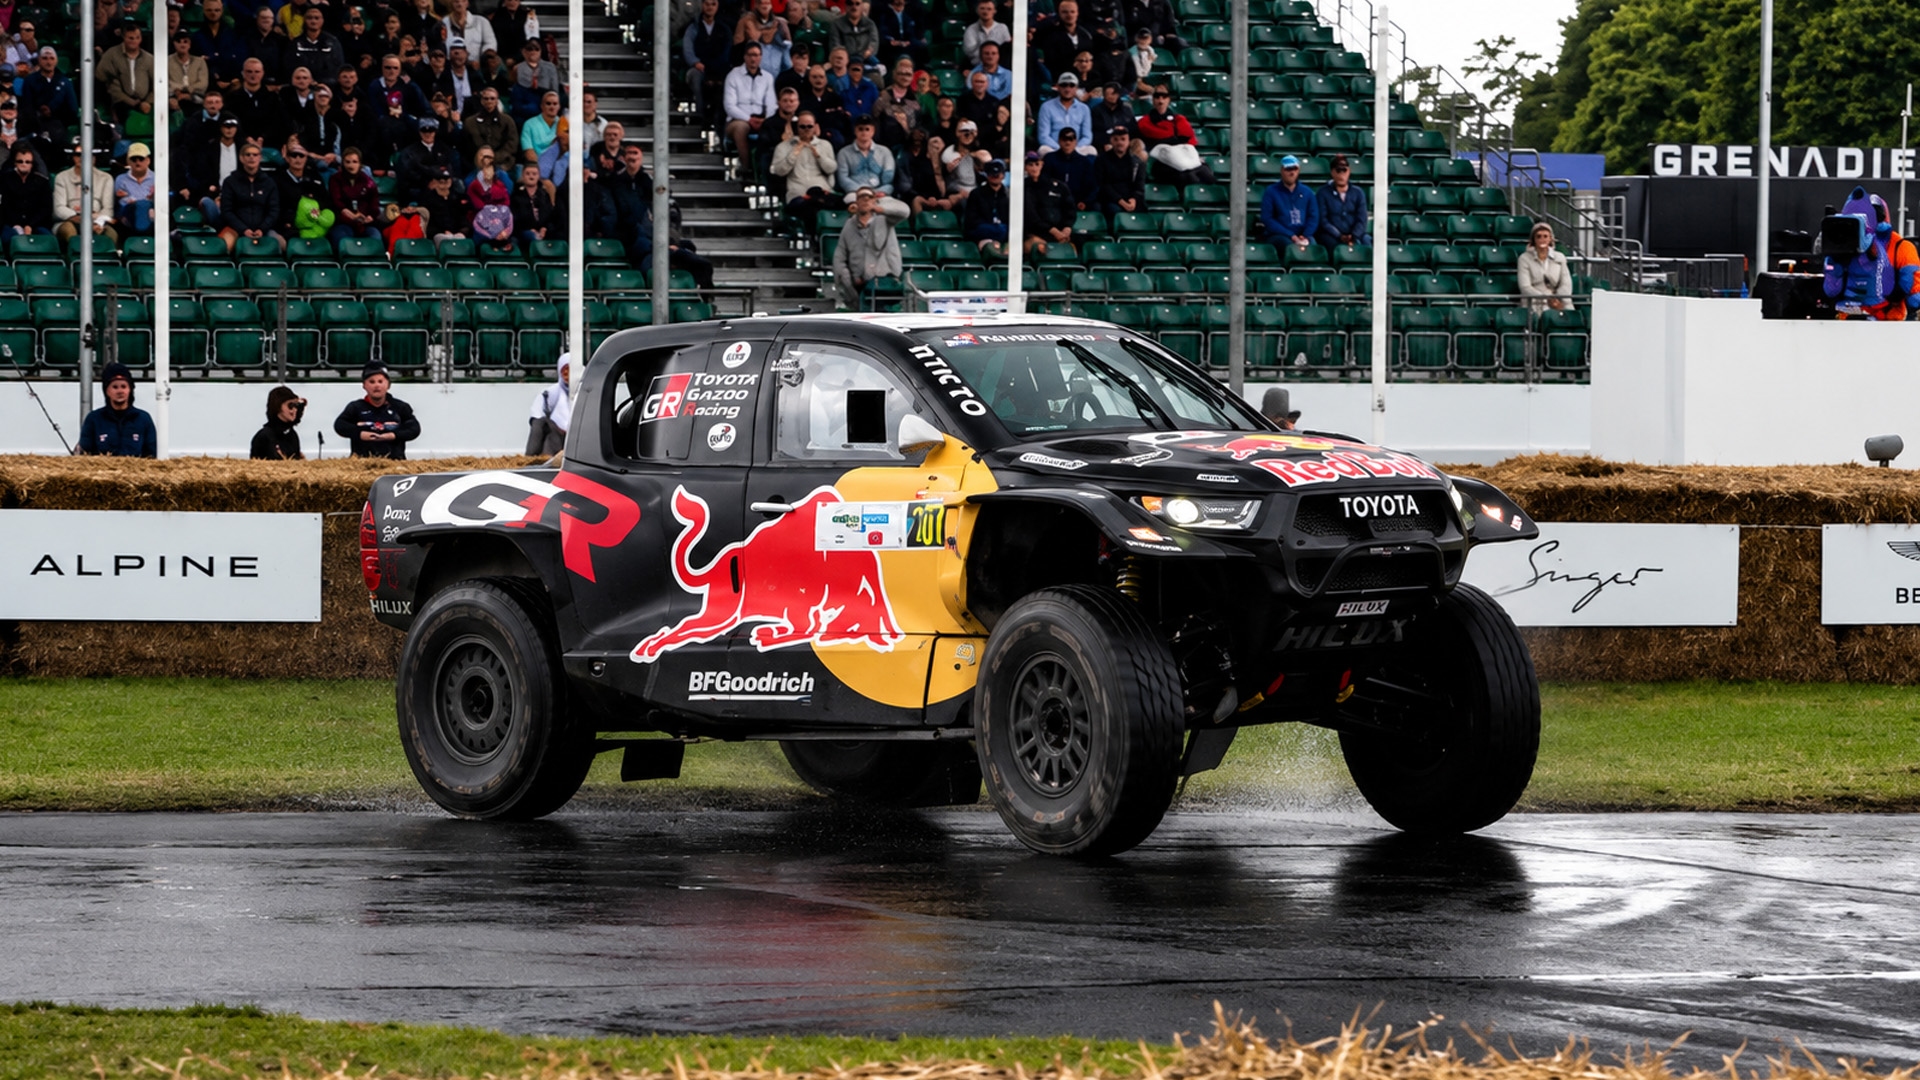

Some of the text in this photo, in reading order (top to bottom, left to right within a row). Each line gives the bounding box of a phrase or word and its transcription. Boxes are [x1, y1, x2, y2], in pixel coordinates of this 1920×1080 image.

[643, 391, 682, 419] GR
[682, 401, 741, 419] Racing
[1339, 493, 1421, 518] TOYOTA
[420, 470, 640, 582] GR
[912, 503, 945, 546] 207
[30, 554, 259, 579] ALPINE
[1500, 540, 1664, 613] Singer
[369, 599, 412, 615] HILUX
[1338, 601, 1388, 614] HILUX
[1895, 587, 1920, 604] BE
[1272, 618, 1409, 651] HILUX
[688, 670, 815, 693] BFGoodrich
